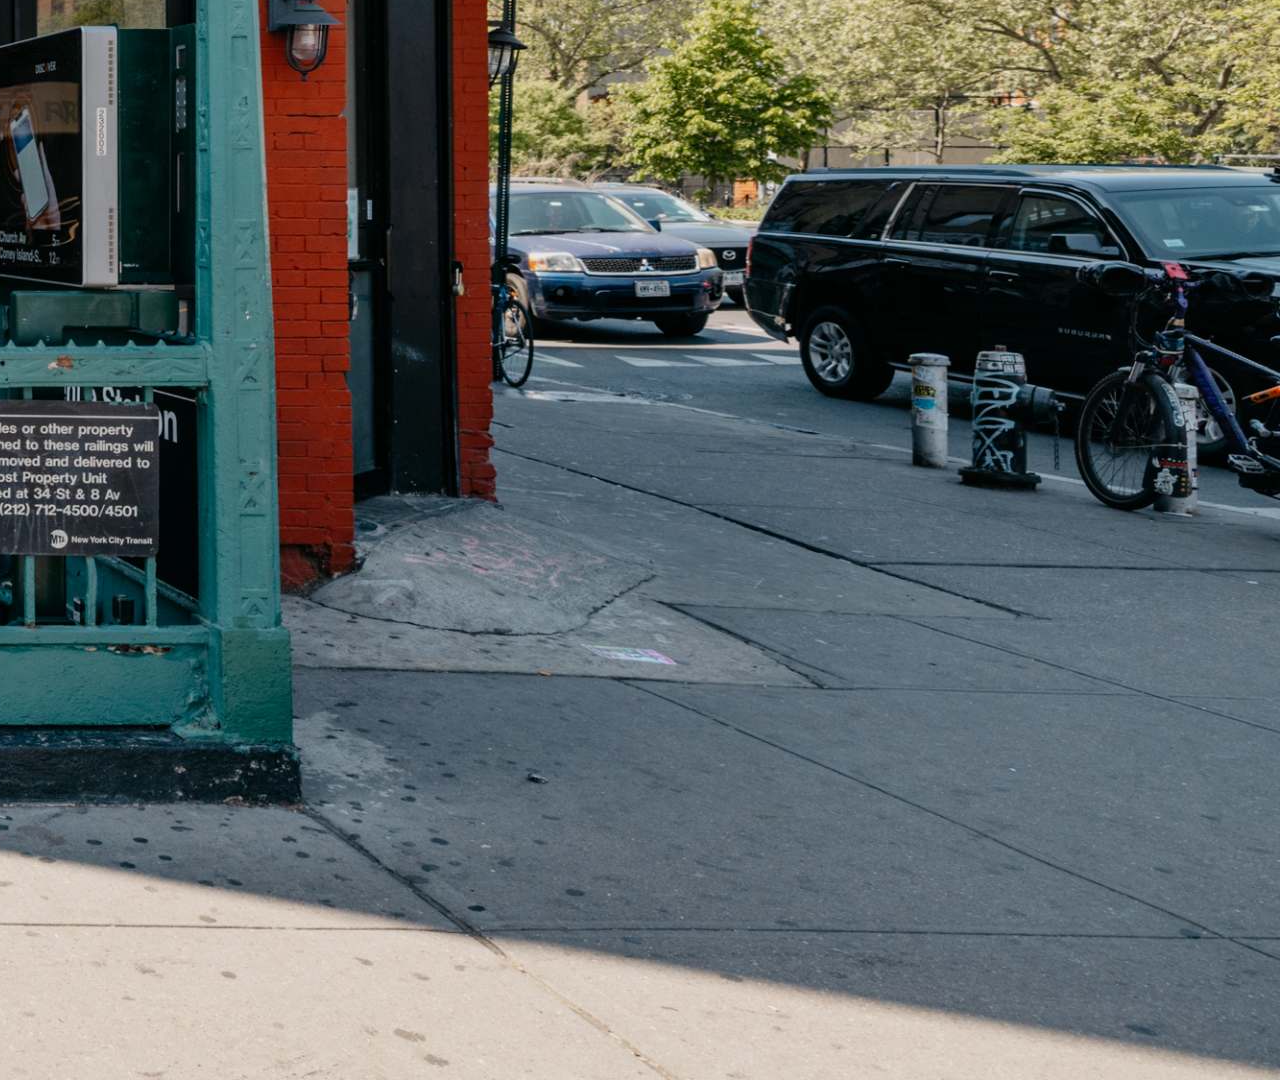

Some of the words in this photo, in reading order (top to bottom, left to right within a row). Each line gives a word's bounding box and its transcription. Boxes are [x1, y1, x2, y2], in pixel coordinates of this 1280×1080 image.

[0, 247, 16, 263] Coney
[22, 426, 35, 435] or
[40, 423, 74, 435] other
[78, 424, 134, 438] property
[26, 441, 38, 451] to
[44, 440, 80, 452] these
[84, 440, 129, 454] railings
[133, 441, 154, 452] will
[45, 456, 69, 468] and
[74, 457, 132, 468] delivered
[137, 458, 150, 469] to
[22, 472, 77, 486] Property
[82, 473, 107, 484] Unit
[16, 489, 28, 499] at
[33, 488, 51, 499] 34
[56, 488, 71, 500] St
[75, 489, 85, 500] &
[90, 489, 101, 500] 8
[105, 489, 120, 501] Av
[0, 503, 30, 516] (212)
[35, 504, 139, 518] 712-4500/4501
[71, 536, 89, 544] New
[90, 536, 107, 544] York
[109, 536, 124, 545] City
[125, 537, 153, 545] Transit
